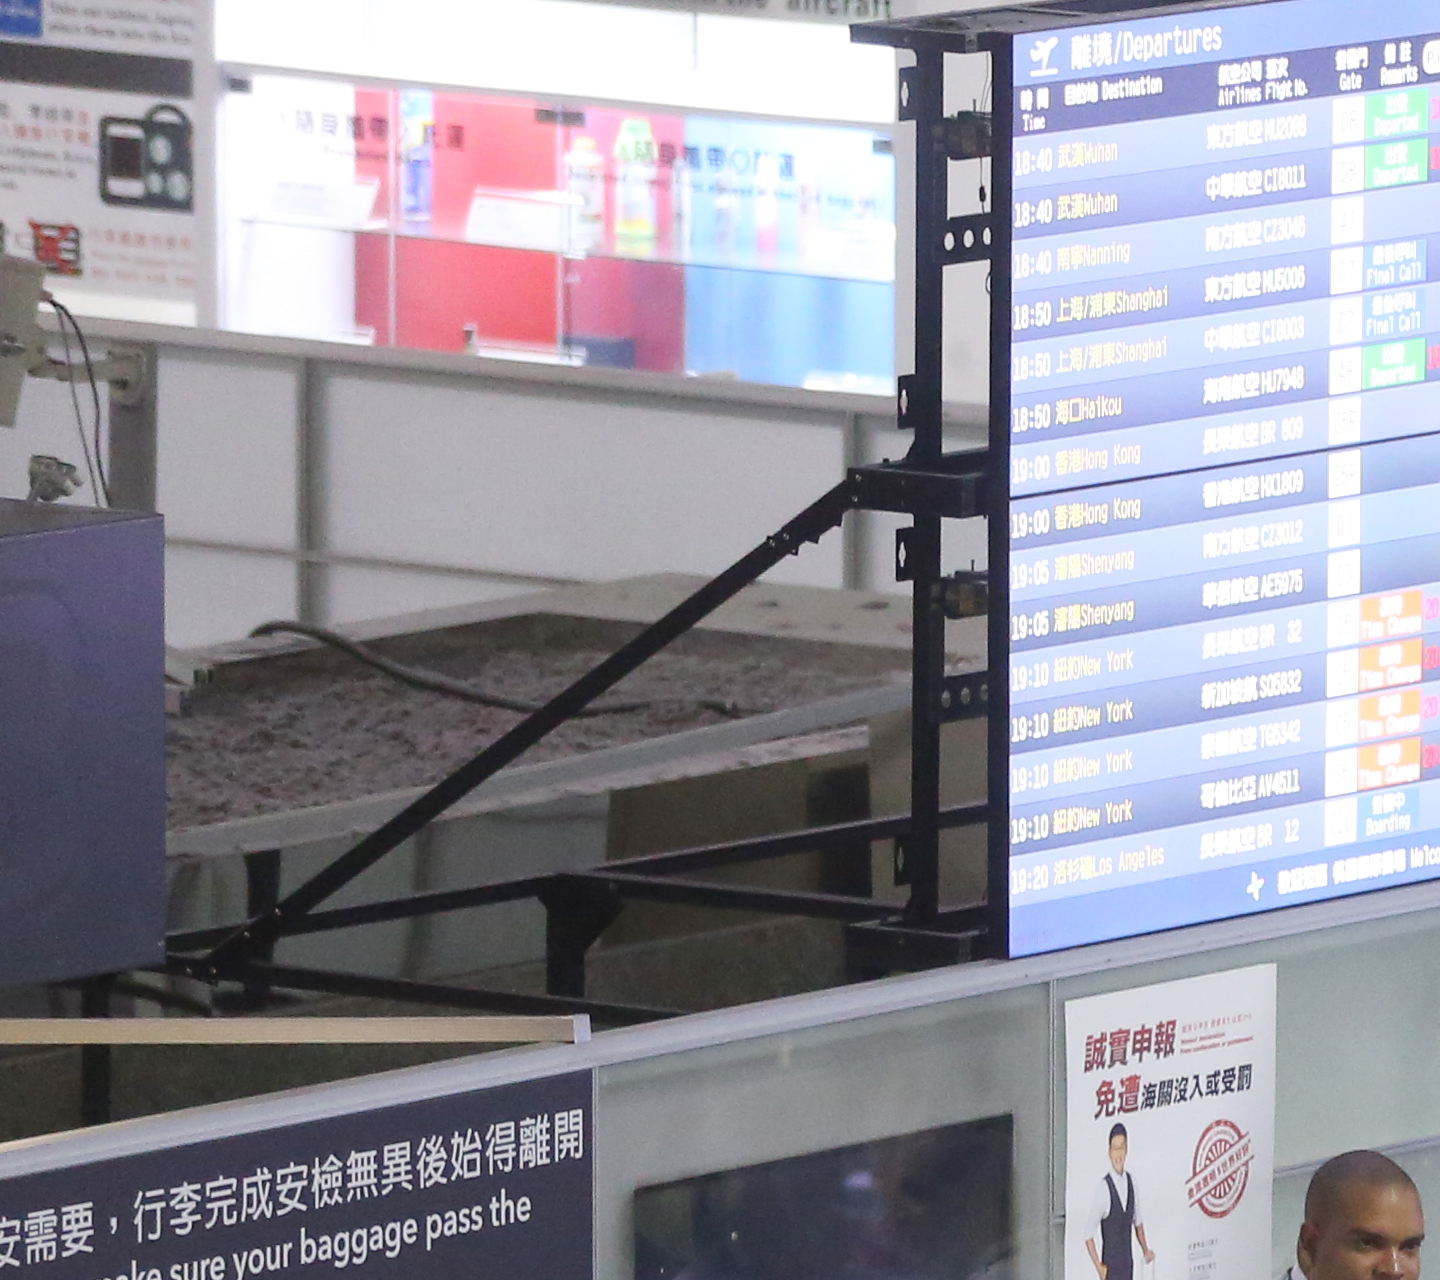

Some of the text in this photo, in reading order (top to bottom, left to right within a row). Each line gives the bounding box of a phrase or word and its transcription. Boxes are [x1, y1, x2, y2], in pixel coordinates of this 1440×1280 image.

[1070, 24, 1223, 70] 離境/Departures
[1022, 114, 1046, 132] Time
[1218, 86, 1261, 106] Airlines
[1265, 80, 1293, 101] Flight
[1339, 72, 1362, 90] Gate
[1380, 63, 1418, 85] Remarks
[1102, 75, 1163, 99] Destination
[1014, 148, 1053, 177] 18:40
[1014, 199, 1053, 229] 18:40
[1014, 250, 1052, 279] 18:40
[1013, 302, 1051, 331] 18:50
[1012, 403, 1051, 433] 18:50
[1012, 509, 1050, 538] 19:00
[1113, 497, 1141, 520] Kong
[1260, 471, 1304, 500] HX1809
[1011, 561, 1049, 589] 19:05
[1011, 611, 1049, 640] 19:05
[1012, 663, 1048, 691] 19:10
[1107, 649, 1134, 674] York
[1012, 764, 1048, 793] 19:10
[1107, 750, 1134, 774] York
[1012, 815, 1048, 844] 19:10
[1107, 800, 1133, 824] York
[1012, 865, 1048, 895] 19:20
[1119, 845, 1165, 875] Angeles
[1084, 1020, 1176, 1073] 誠實申報
[1094, 1064, 1253, 1119] 免遭海關沒入或受罰
[301, 1217, 417, 1269] baggage
[426, 1206, 483, 1250] pass
[490, 1188, 531, 1227] the
